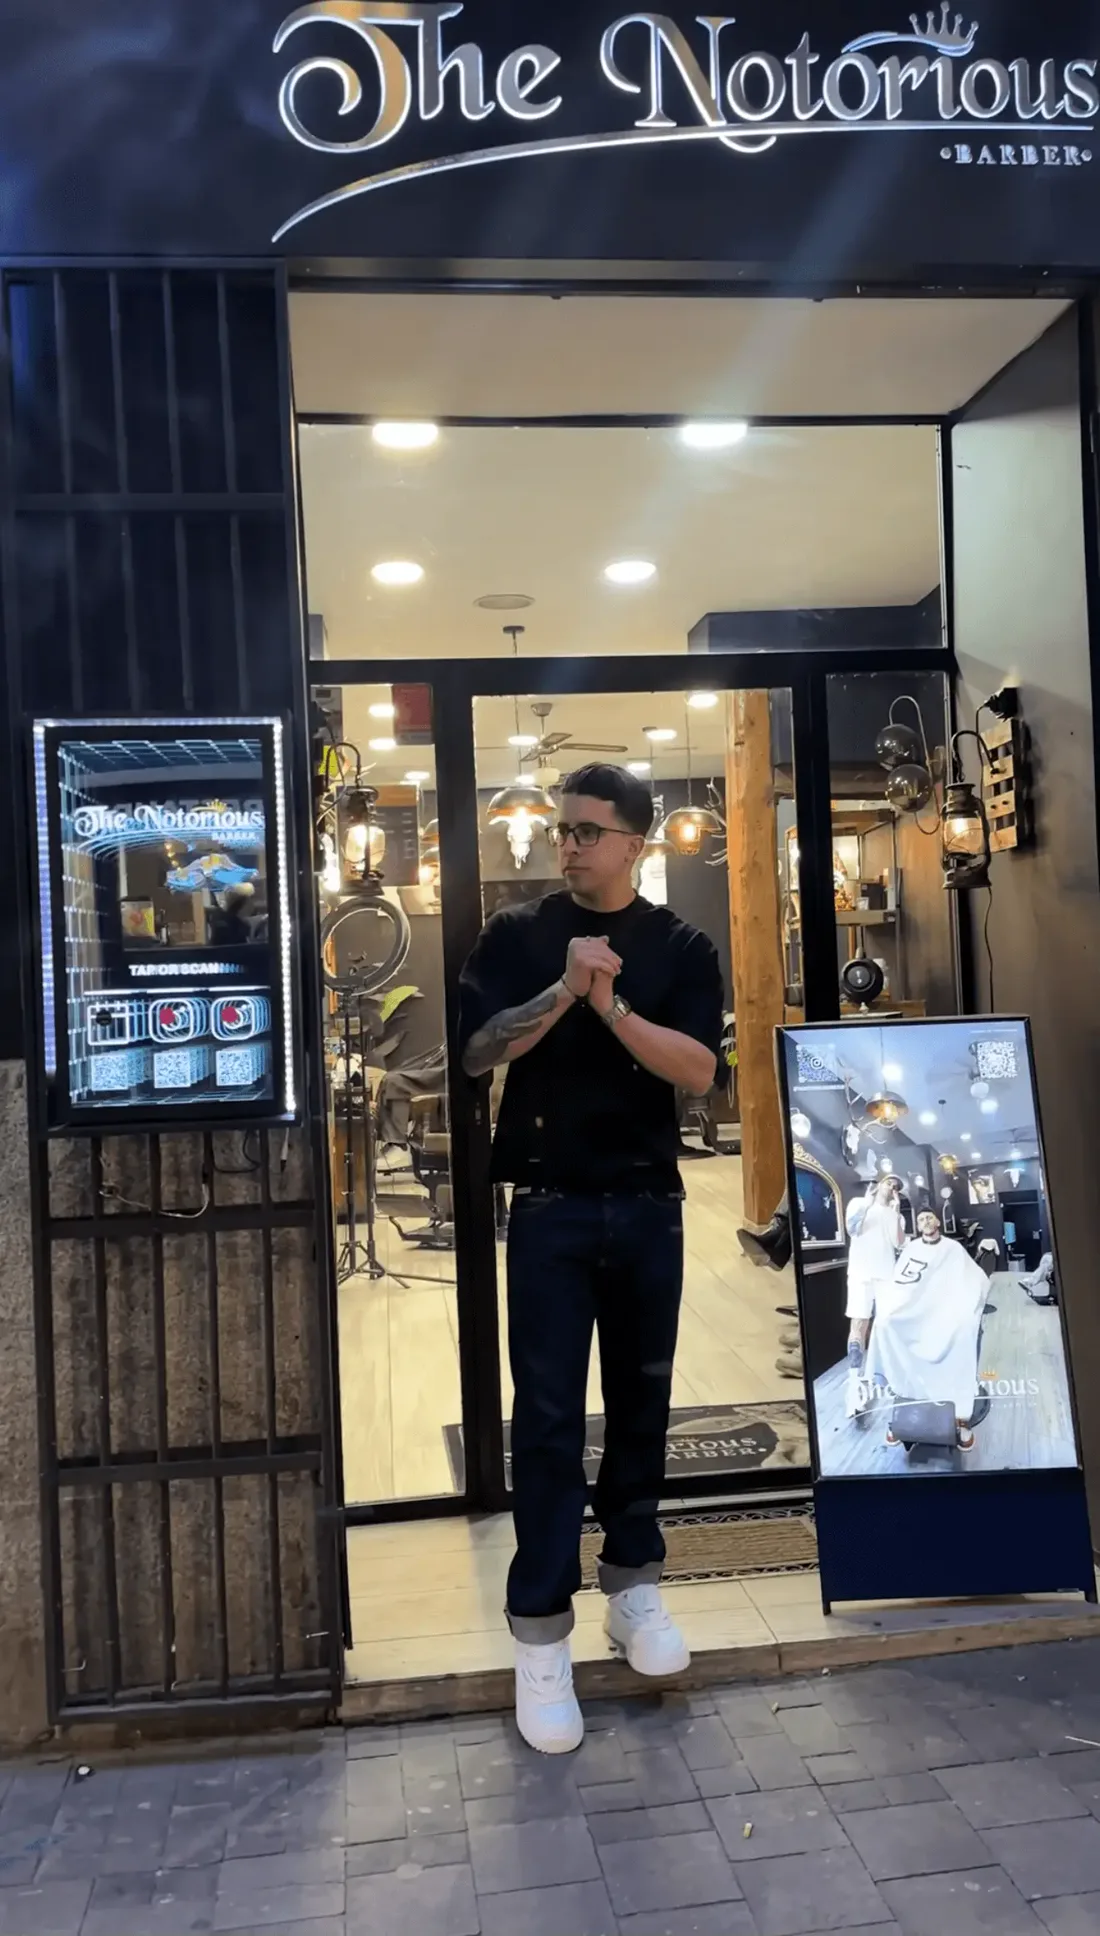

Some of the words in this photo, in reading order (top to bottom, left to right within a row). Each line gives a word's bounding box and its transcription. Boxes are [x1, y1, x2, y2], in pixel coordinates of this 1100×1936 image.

[272, 0, 562, 153] The
[600, 13, 1100, 152] Notorious
[74, 805, 127, 838] The
[134, 805, 266, 830] Notorious
[665, 1447, 757, 1461] ARBER
